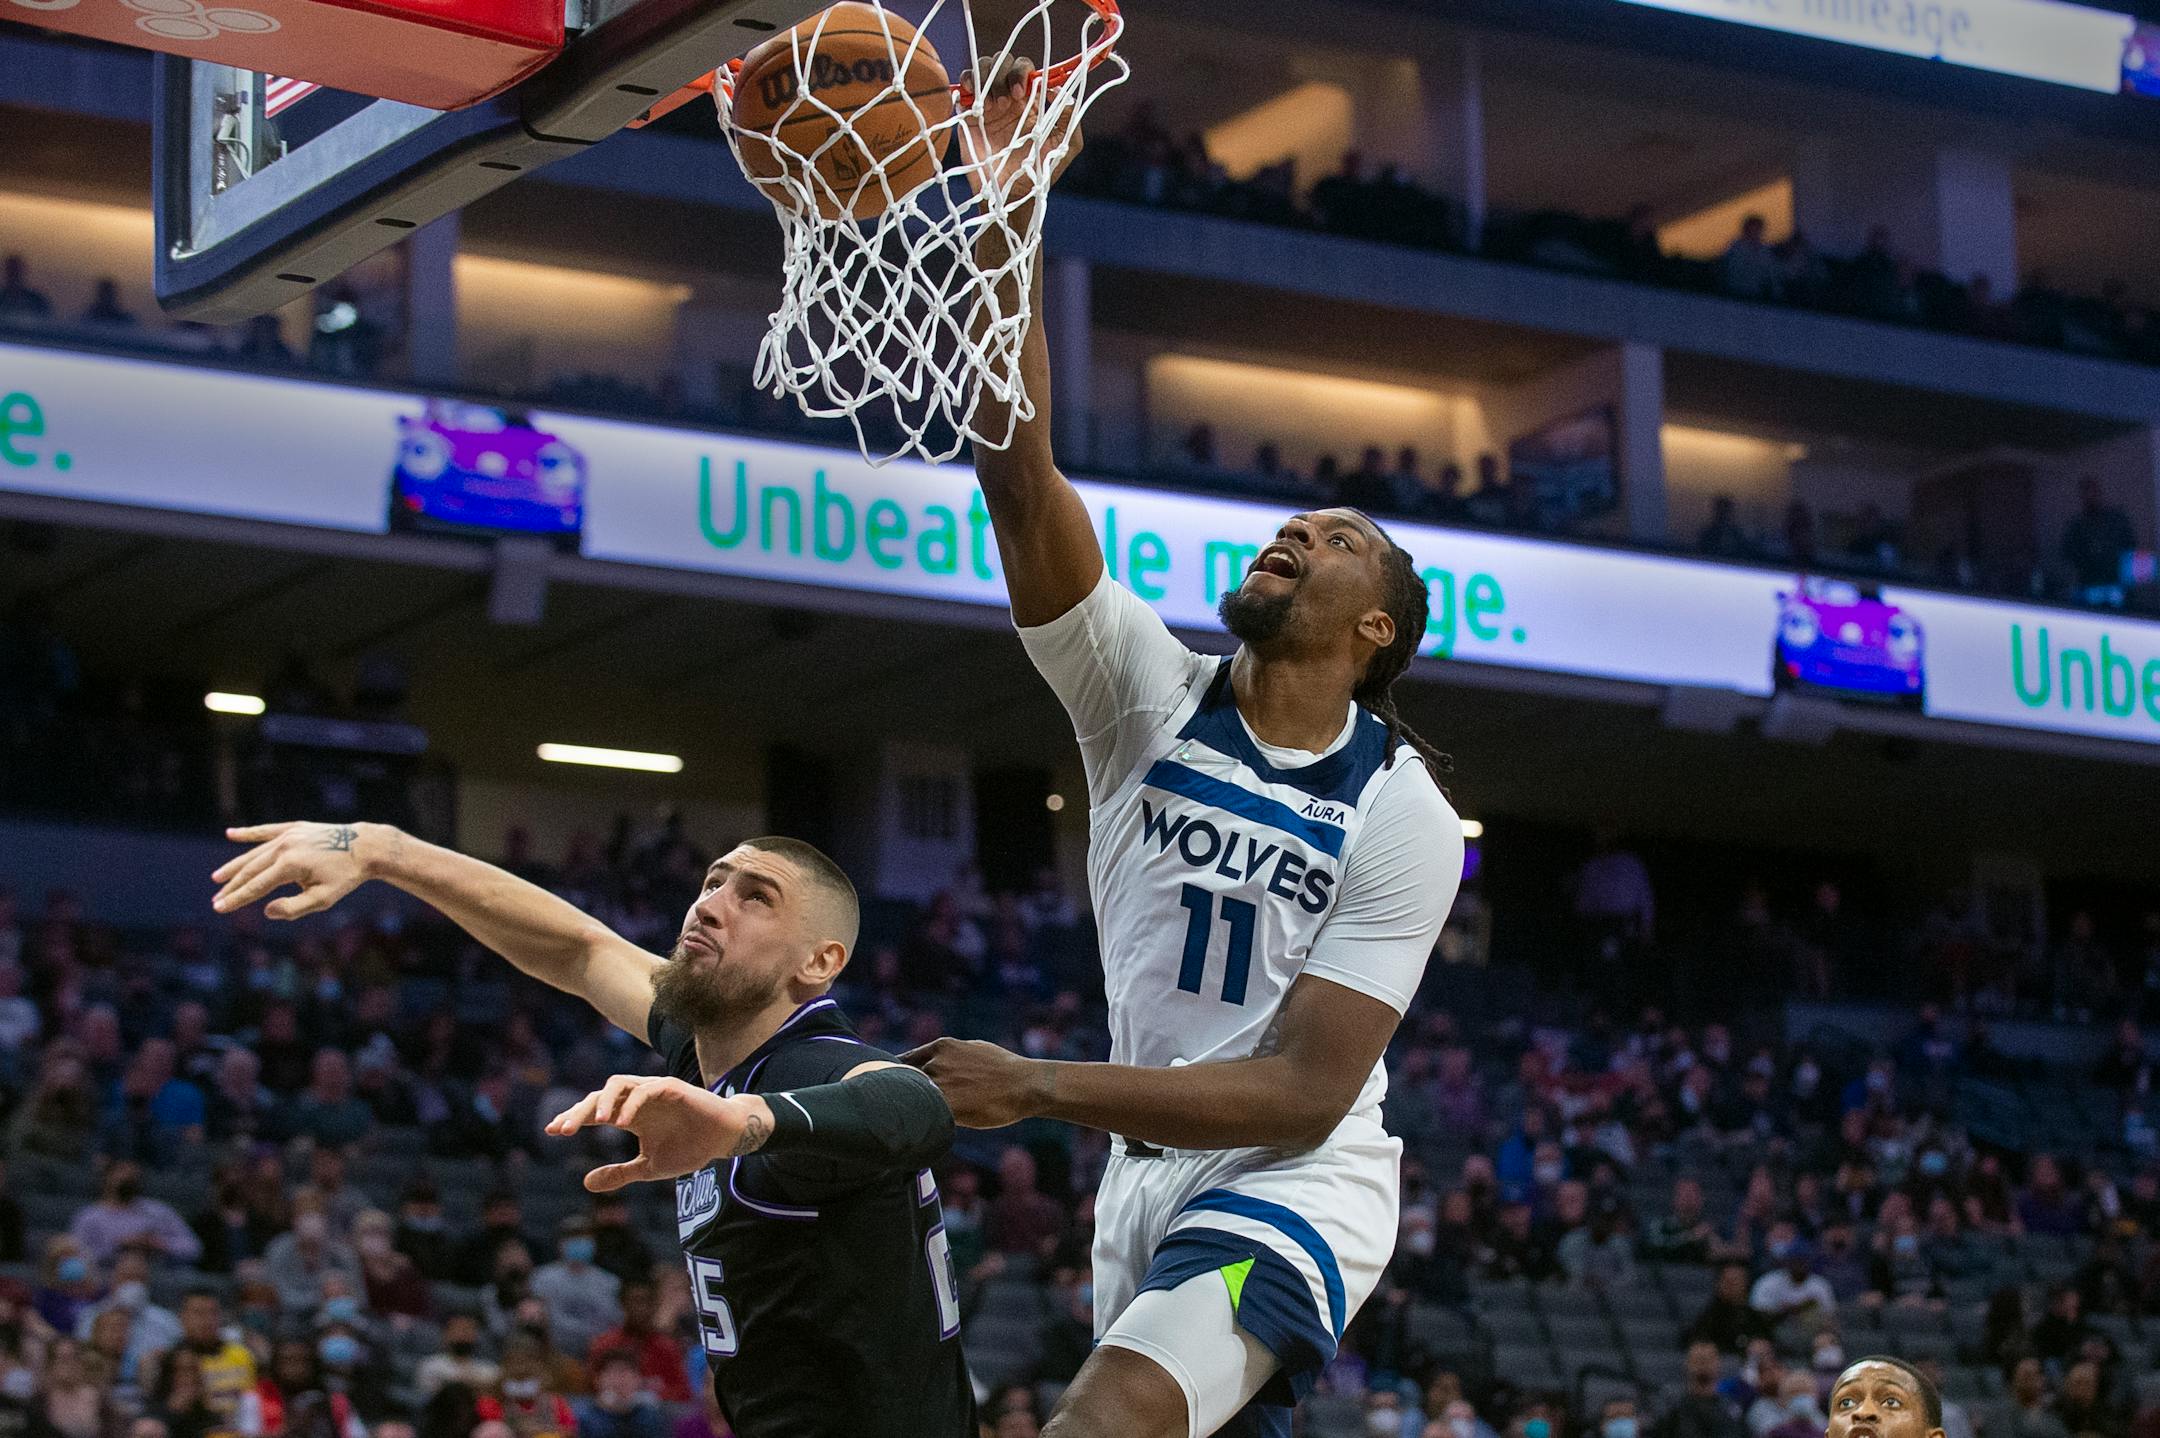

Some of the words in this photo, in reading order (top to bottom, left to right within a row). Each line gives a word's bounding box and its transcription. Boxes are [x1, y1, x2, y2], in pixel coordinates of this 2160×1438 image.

[758, 52, 898, 110] Wlson
[699, 456, 1170, 602] Unbeatle
[1142, 798, 1335, 915] WOLVES
[1176, 882, 1257, 1007] 11
[683, 1250, 739, 1358] 5
